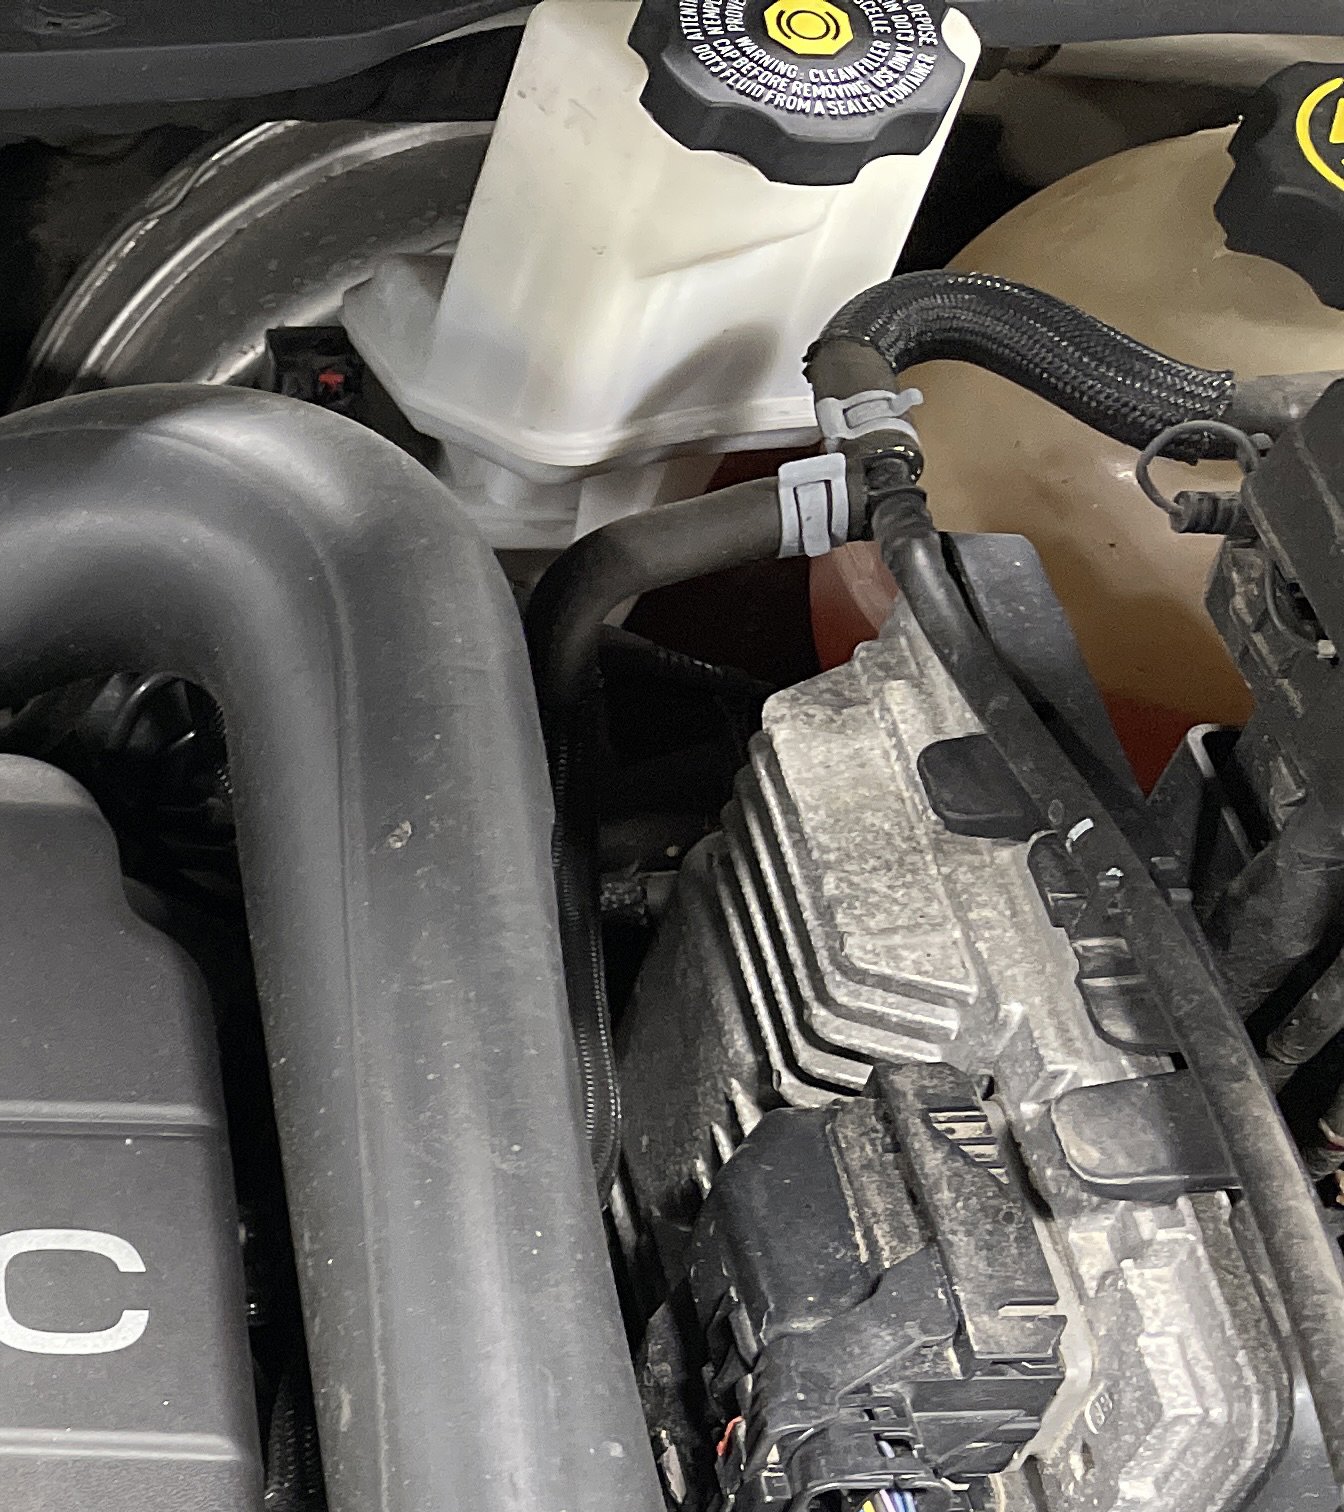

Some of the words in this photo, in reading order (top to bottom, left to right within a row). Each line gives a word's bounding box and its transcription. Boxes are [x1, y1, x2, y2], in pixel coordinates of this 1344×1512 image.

[679, 0, 705, 40] ATTENT
[692, 43, 728, 73] DOT3
[718, 68, 765, 98] FLUID
[764, 90, 812, 113] FROM
[813, 100, 826, 115] A
[826, 94, 886, 116] SEALED
[712, 38, 741, 59] CAP
[732, 56, 790, 92] BEFORE
[870, 66, 900, 88] USE
[887, 42, 914, 72] ONLY
[808, 64, 861, 83] CLEAN
[853, 40, 892, 75] FILLER
